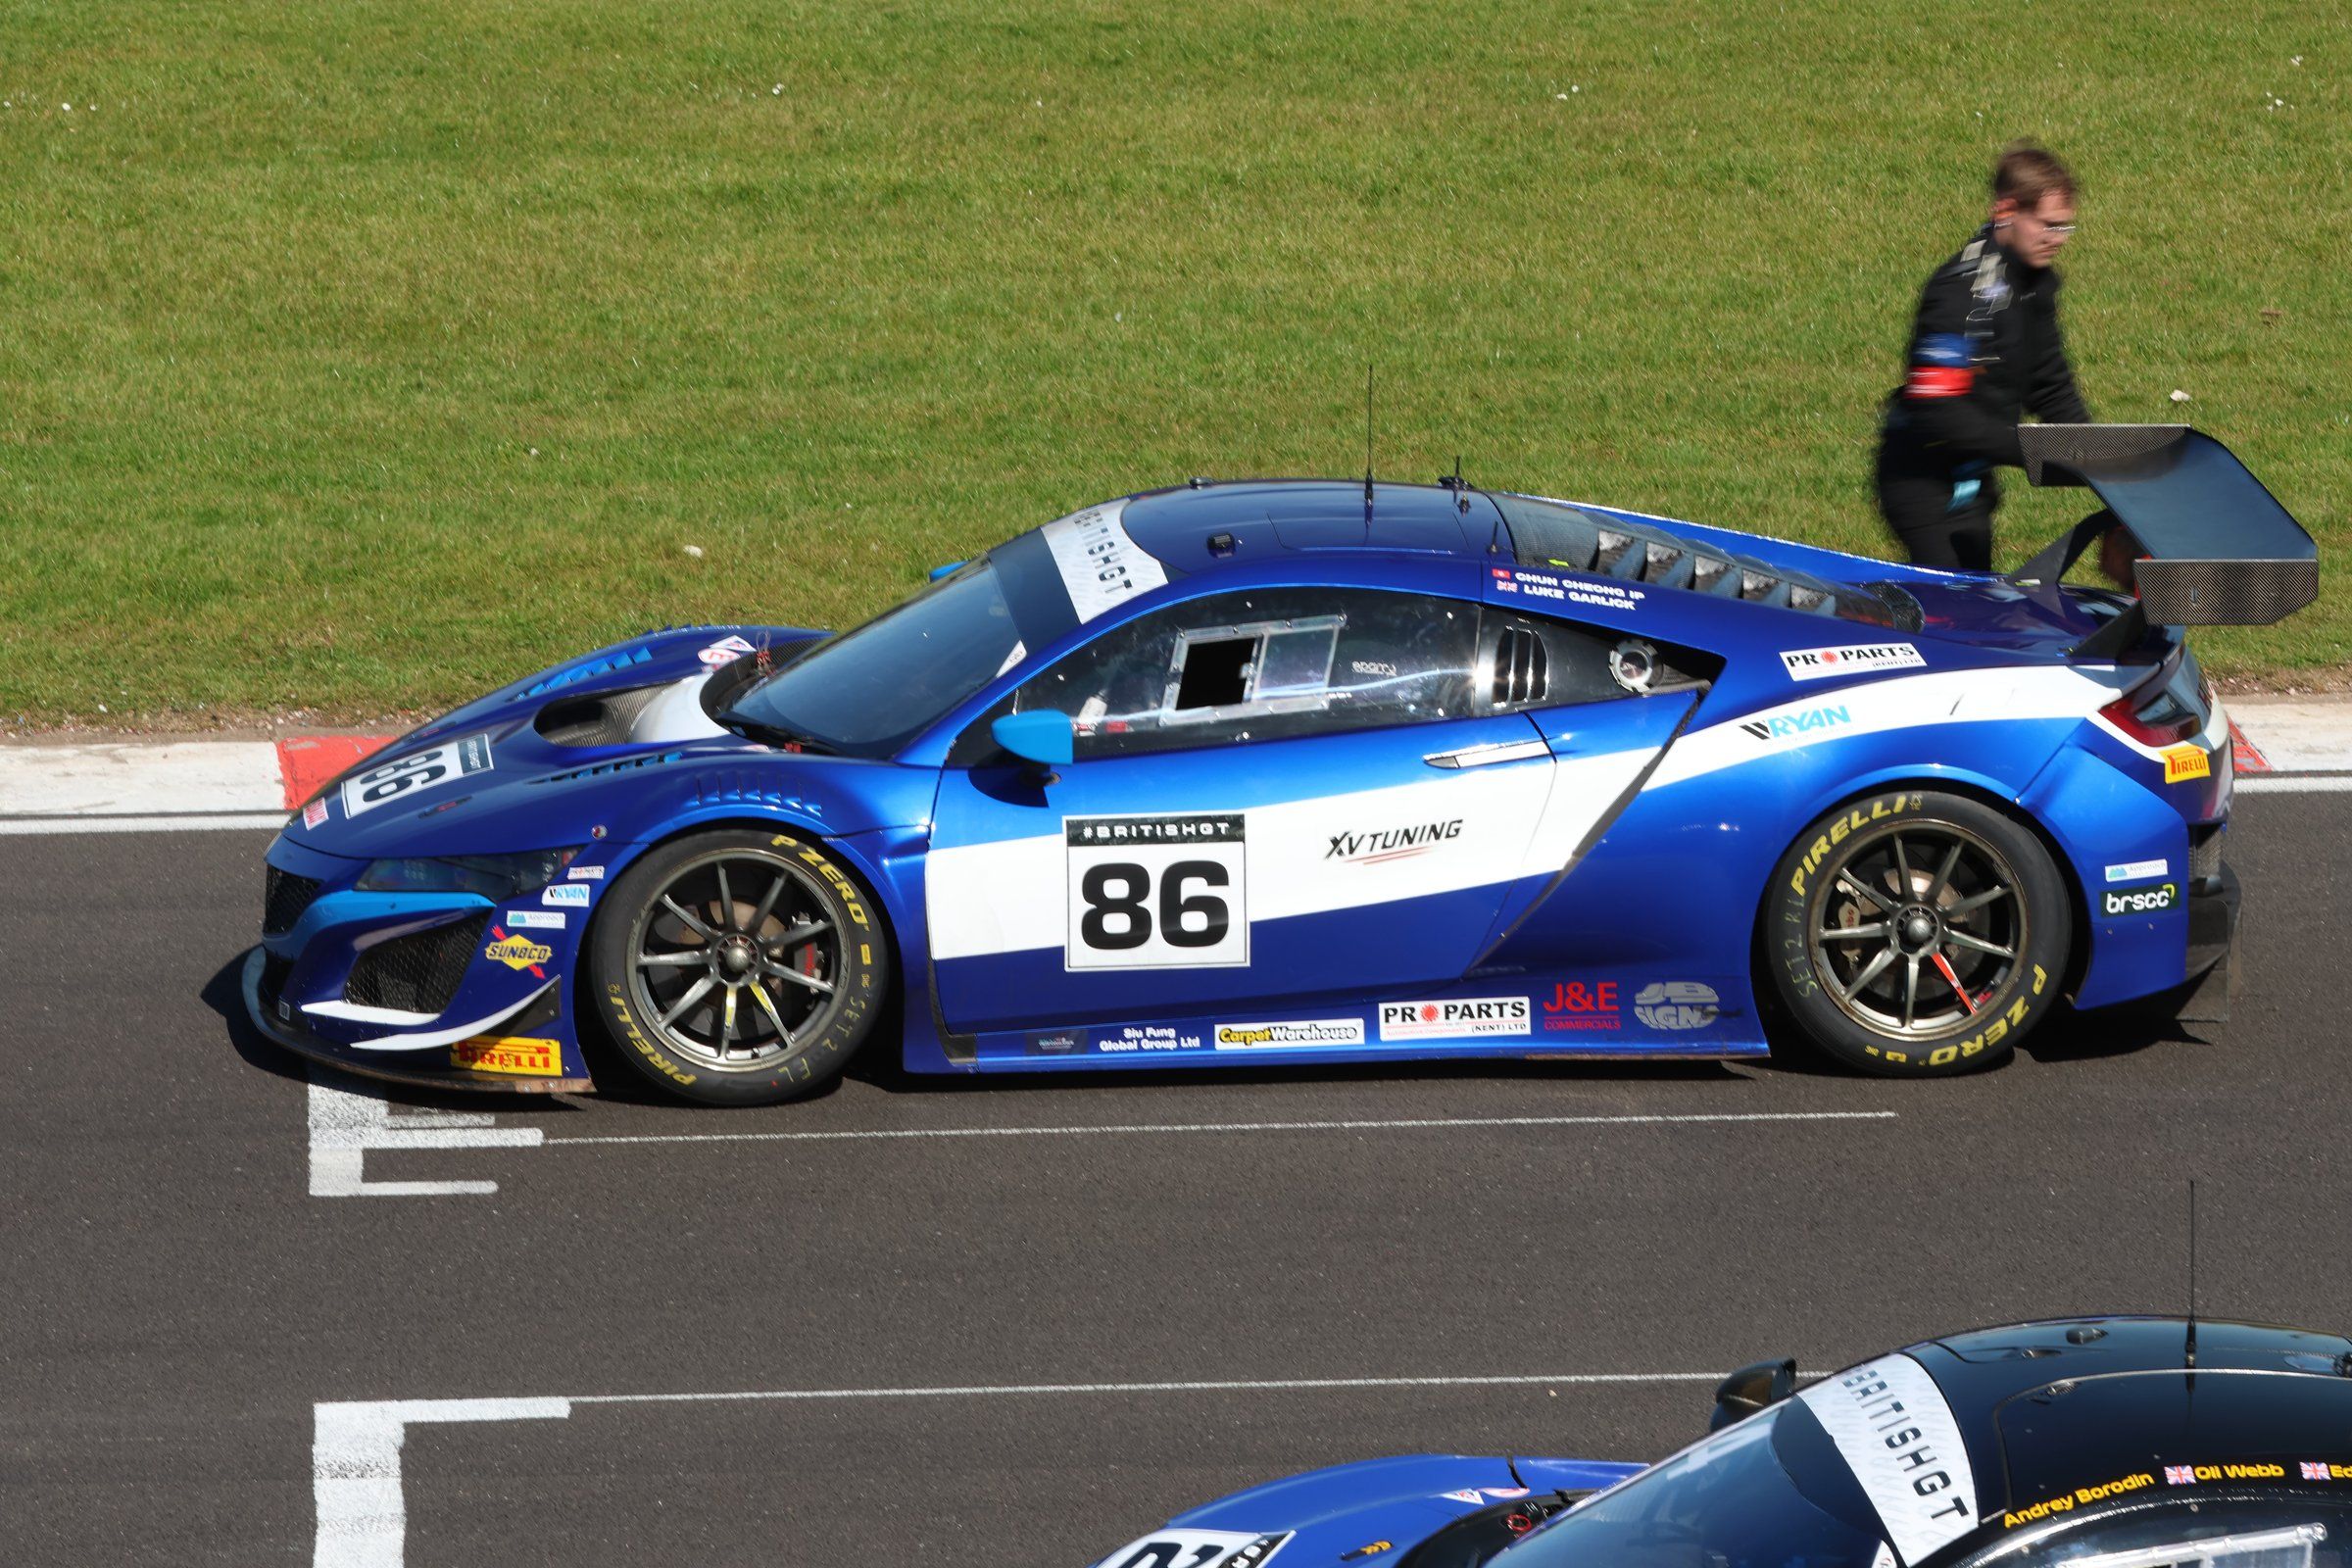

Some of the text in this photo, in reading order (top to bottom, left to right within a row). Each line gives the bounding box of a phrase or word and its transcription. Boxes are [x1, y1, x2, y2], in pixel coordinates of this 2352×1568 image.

[1515, 572, 1645, 601] CHUN CHEONG IP
[1523, 584, 1637, 611] LUKE GARLICK
[2167, 750, 2207, 775] PIRELLI
[1083, 822, 1230, 839] #BRITISHGT
[1790, 795, 1907, 897] PIRELLI
[771, 834, 870, 924] P ZERO
[1081, 860, 1229, 950] 86
[2106, 891, 2170, 913] brscc
[489, 945, 548, 960] SUNOCO
[1543, 981, 1619, 1012] J&E
[1544, 1018, 1621, 1030] COMMERCIALS
[1928, 963, 2048, 1066] P ZERO
[611, 997, 698, 1085] PIRELLI
[1099, 1037, 1200, 1052] Global Group Ltd
[1123, 1027, 1176, 1039] Siu Fung
[458, 1039, 551, 1068] PIRELLI
[1842, 1370, 1969, 1519] BRITISHGT
[2194, 1464, 2284, 1481] Oli Webb
[2003, 1472, 2155, 1528] Andrey Borodin
